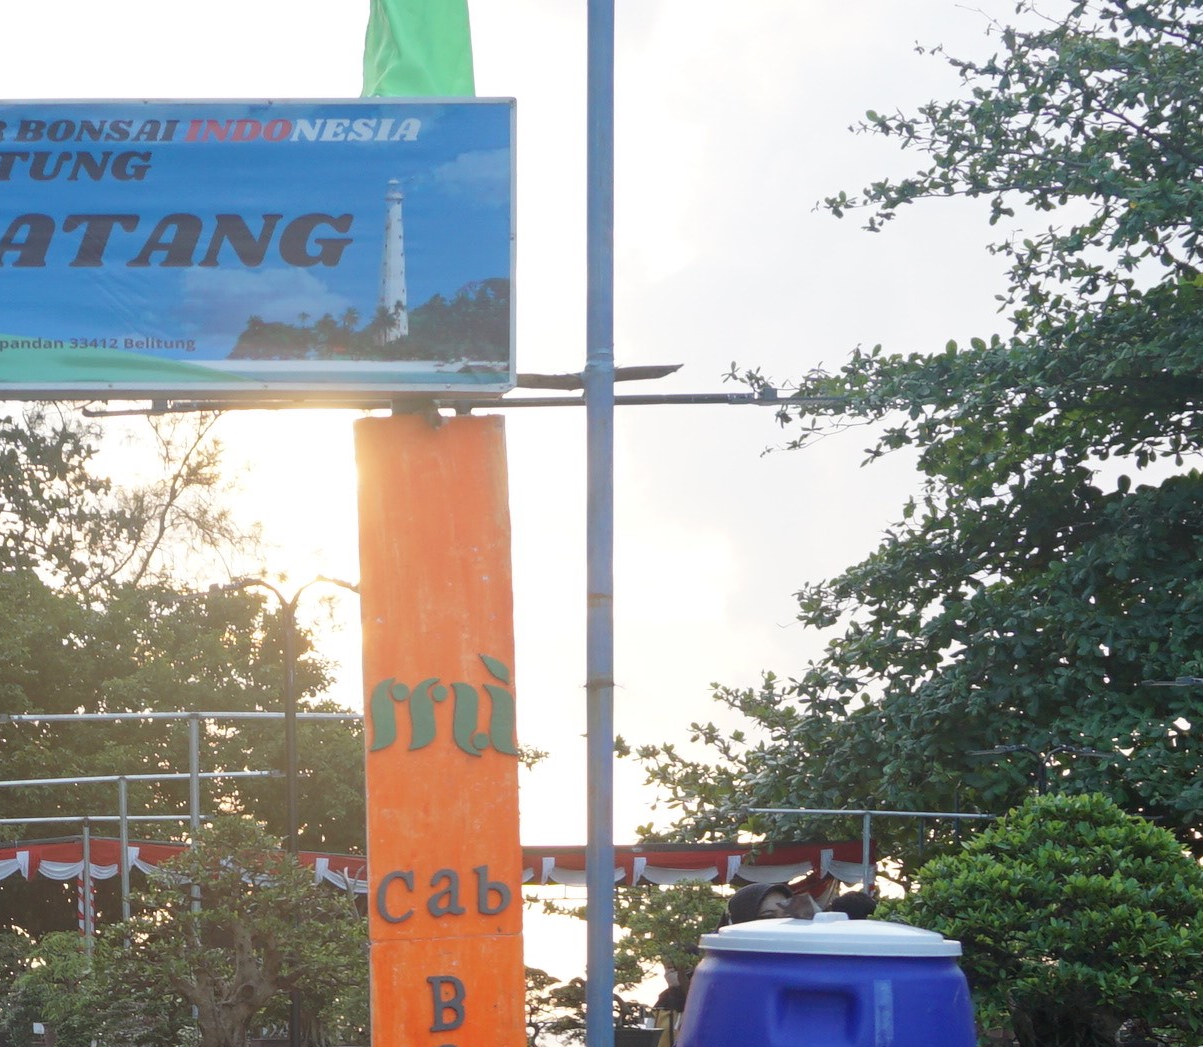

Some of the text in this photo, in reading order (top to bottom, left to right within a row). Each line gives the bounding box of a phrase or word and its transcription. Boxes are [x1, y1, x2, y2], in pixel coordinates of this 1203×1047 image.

[13, 119, 180, 142] BONSAI
[184, 118, 422, 142] INDONESIA
[68, 336, 119, 349] 33412
[123, 335, 196, 352] Belitung
[376, 864, 512, 925] Cab
